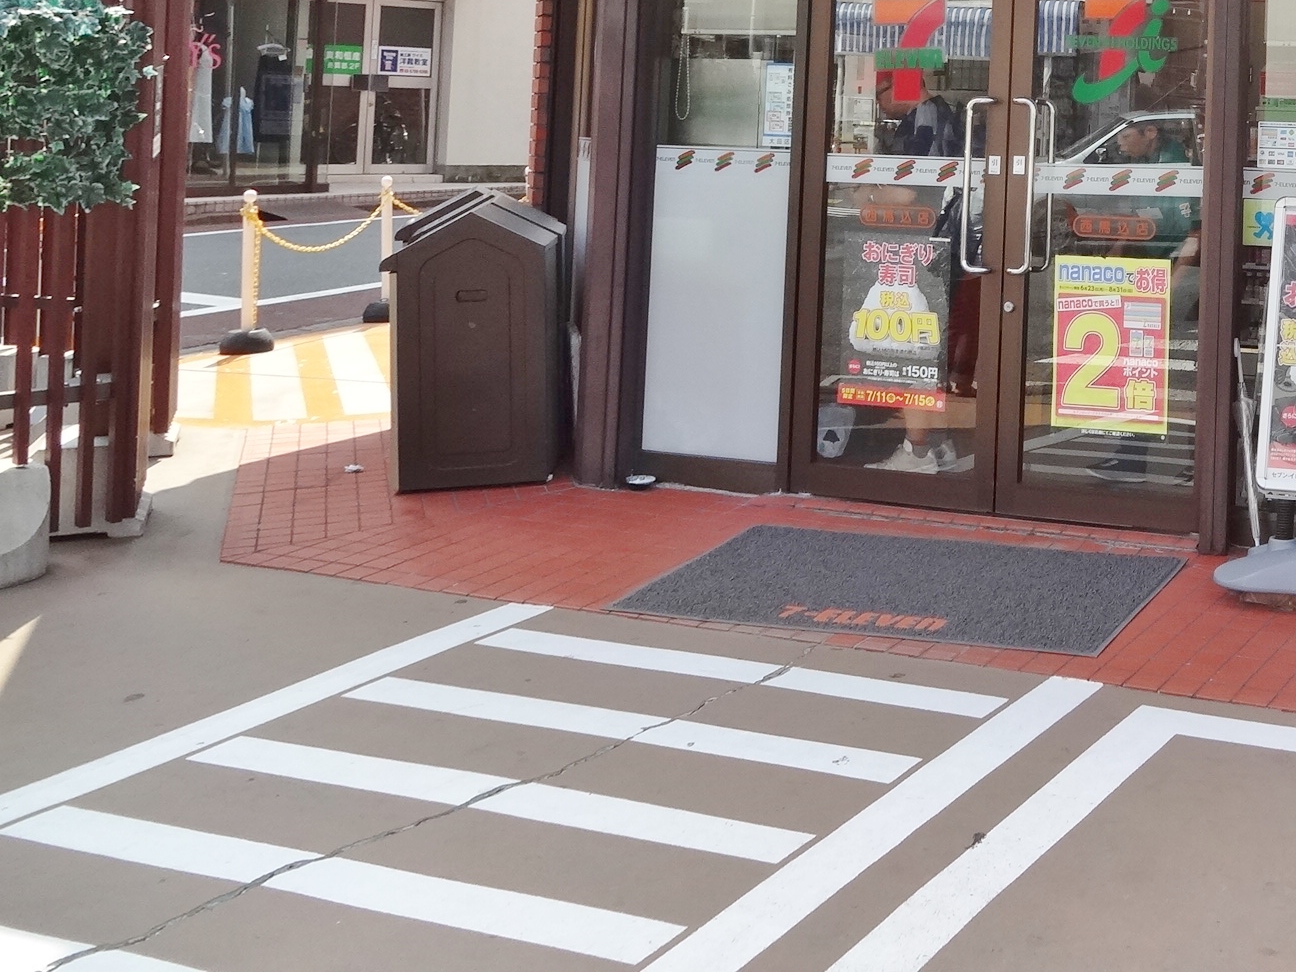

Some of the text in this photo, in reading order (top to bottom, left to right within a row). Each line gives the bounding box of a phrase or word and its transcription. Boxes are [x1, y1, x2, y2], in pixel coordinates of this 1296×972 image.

[862, 241, 934, 266] おにぎり
[879, 264, 916, 286] 寿司
[880, 291, 911, 309] 税込
[854, 309, 941, 345] 100円
[1062, 311, 1121, 409] 2
[906, 365, 938, 379] 150円
[1123, 367, 1158, 379] ポイント
[1125, 378, 1156, 412] 倍
